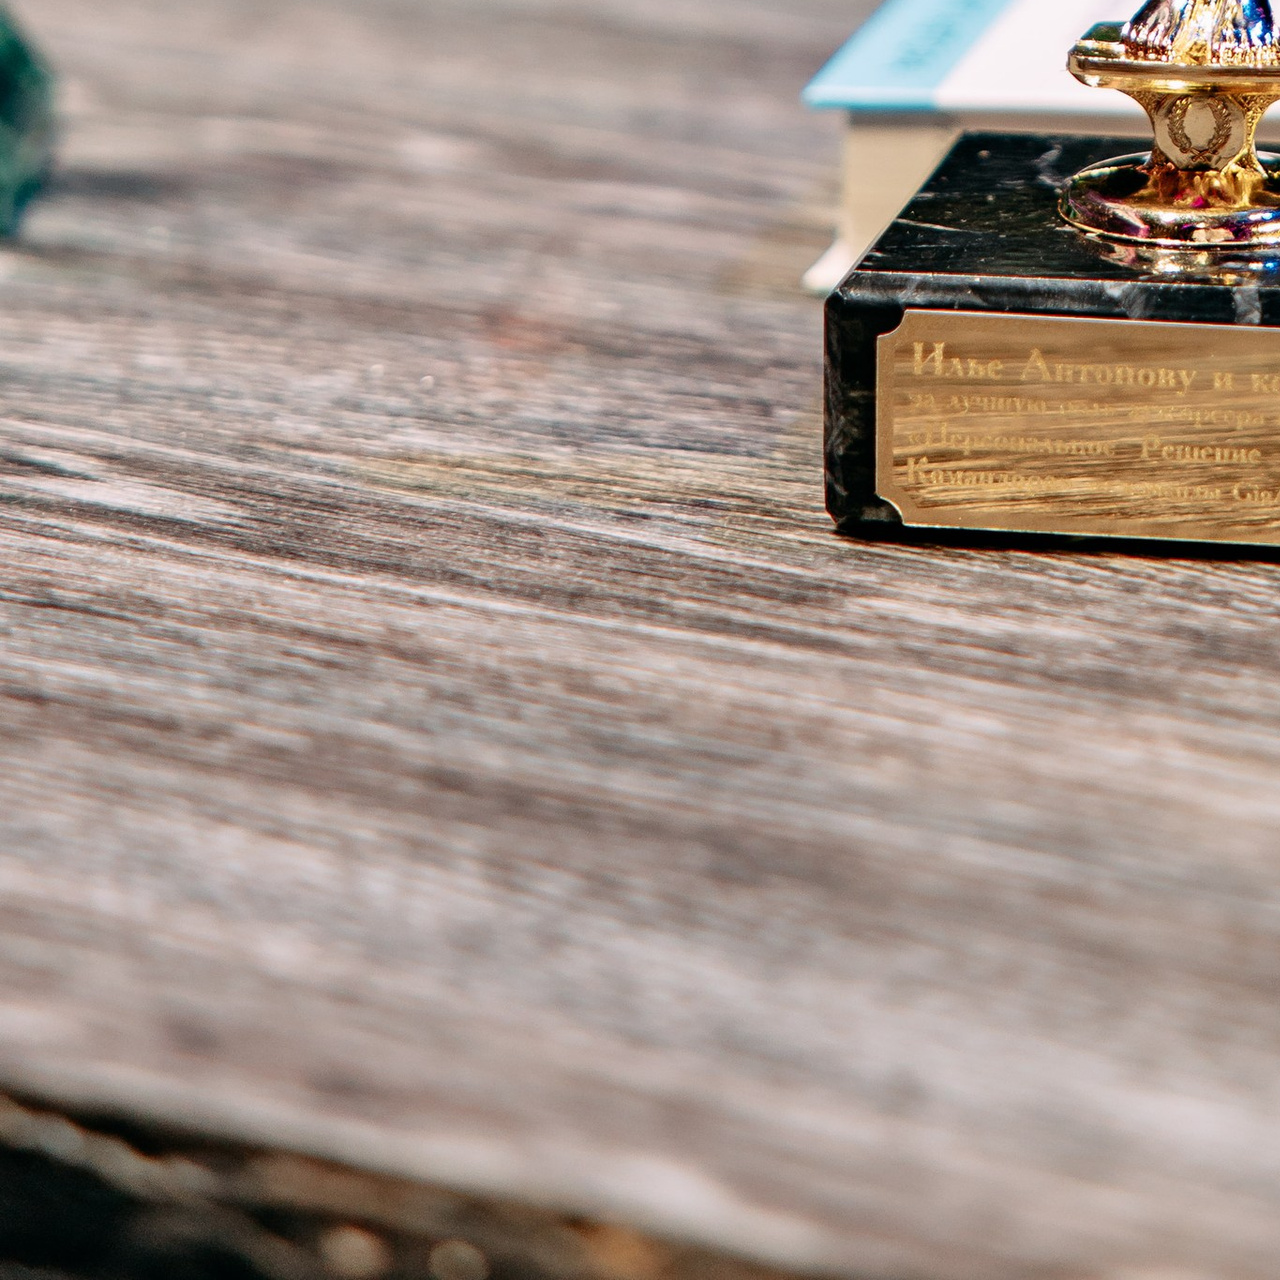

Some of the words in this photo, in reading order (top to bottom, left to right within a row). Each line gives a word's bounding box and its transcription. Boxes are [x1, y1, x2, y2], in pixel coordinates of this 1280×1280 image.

[912, 340, 1004, 380] Илье
[1020, 347, 1197, 398] Антонову
[1213, 370, 1234, 391] и
[951, 394, 1046, 418] лучшую
[1141, 432, 1261, 465] Решение
